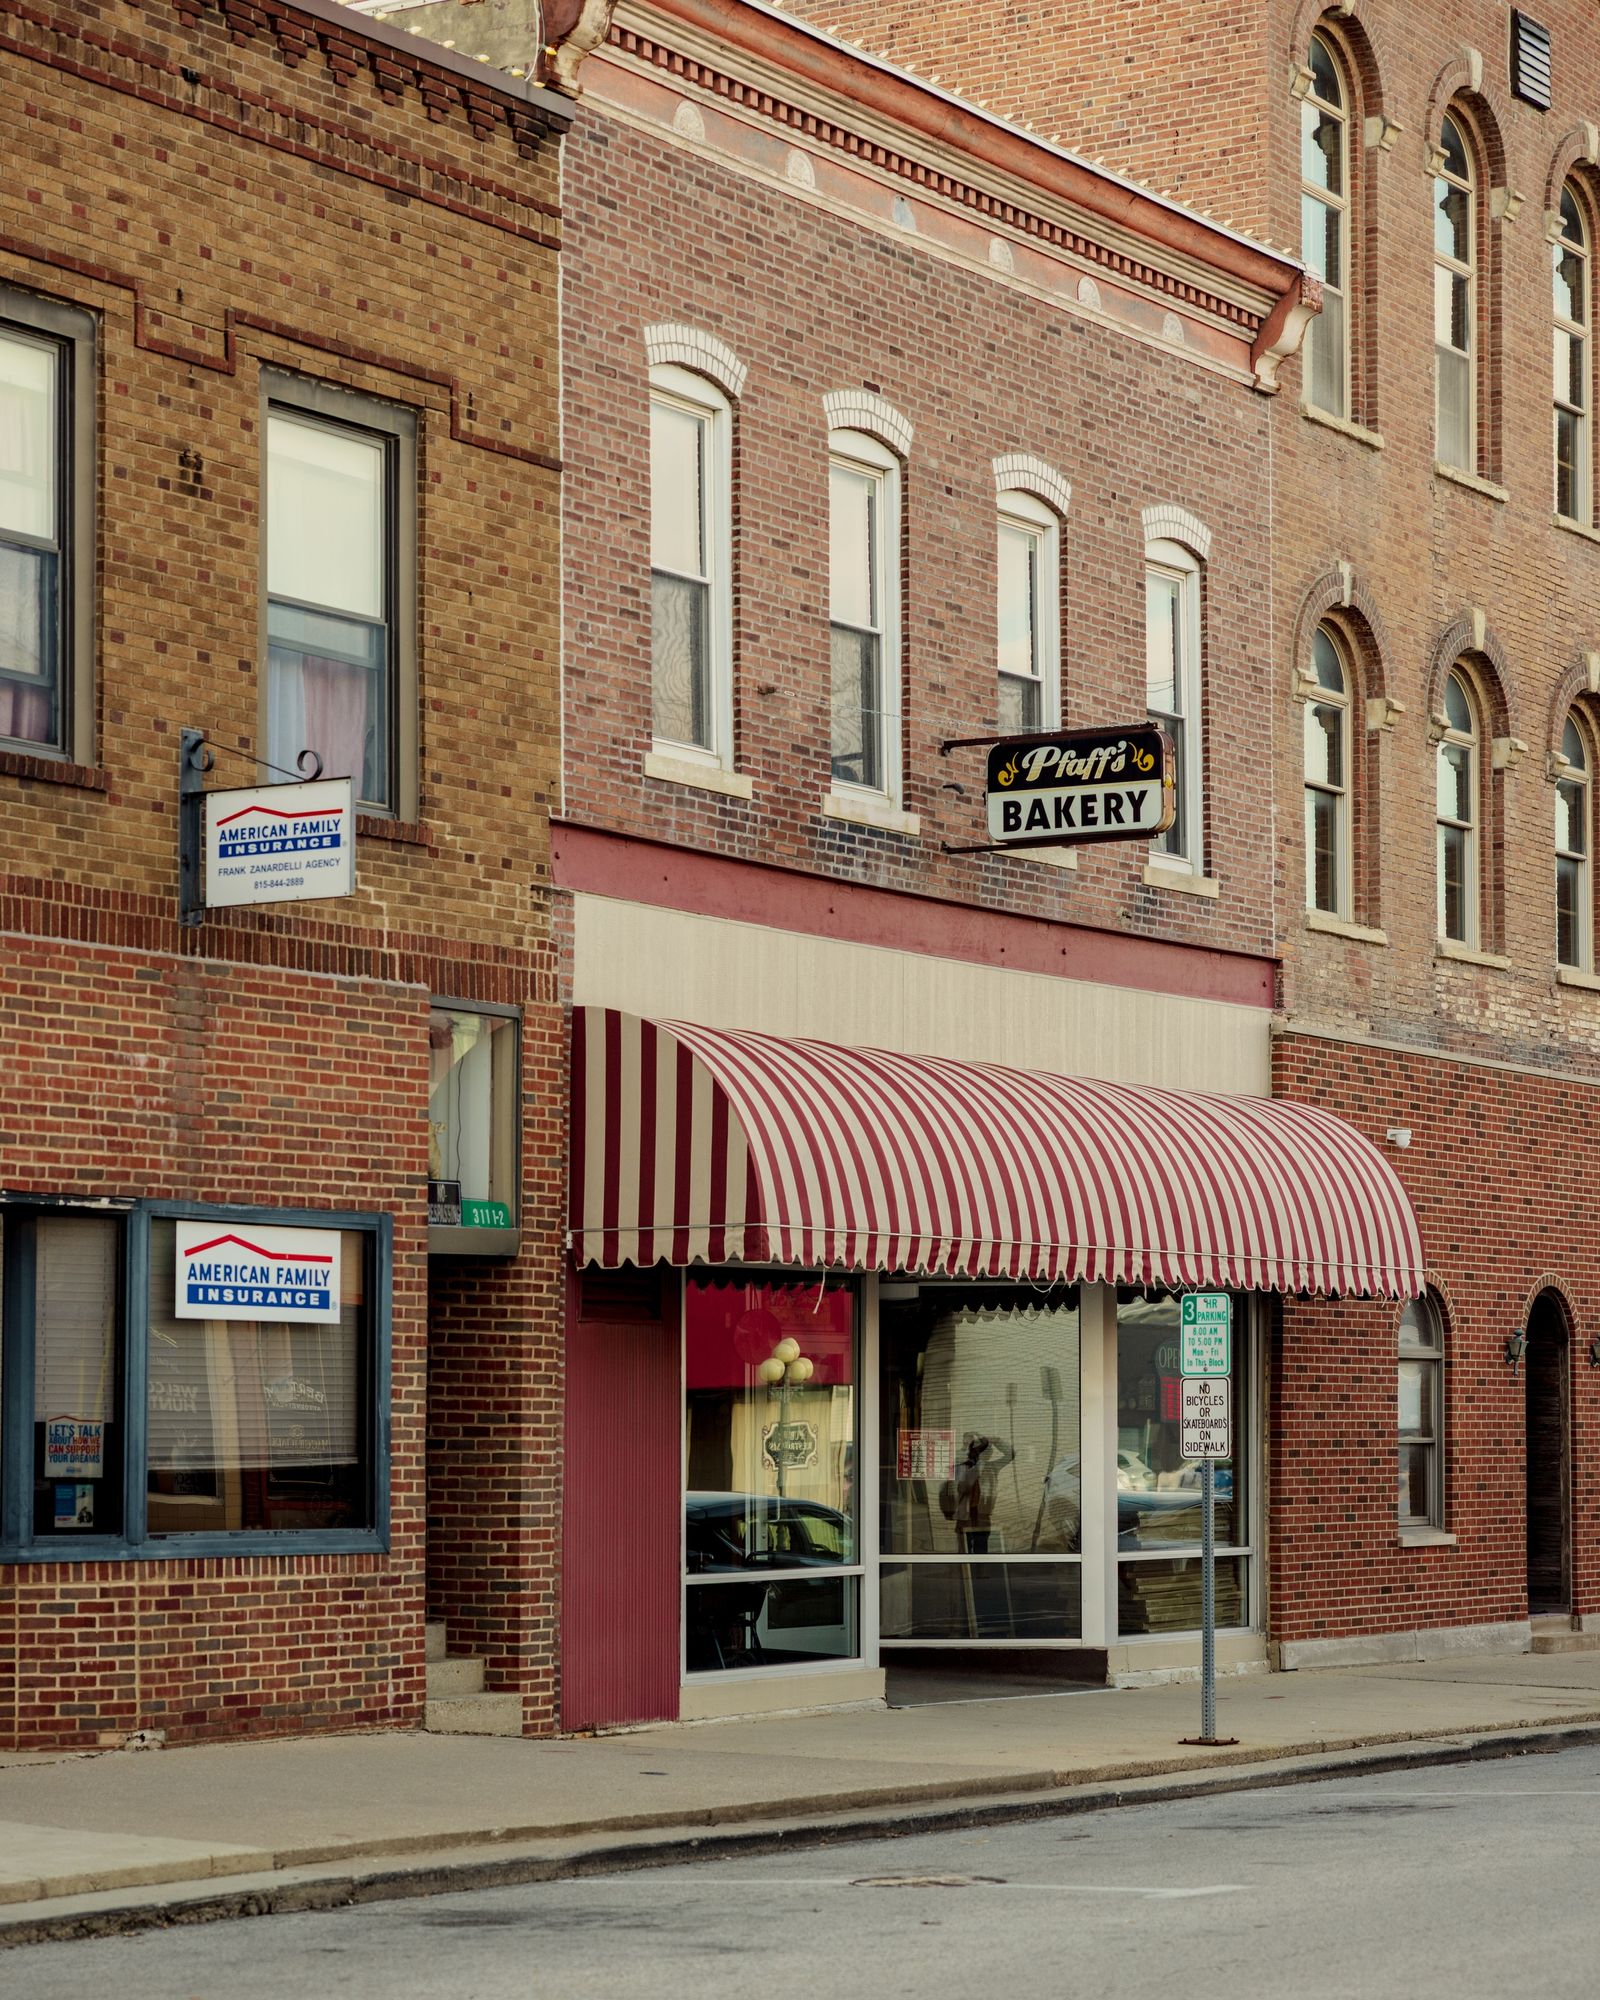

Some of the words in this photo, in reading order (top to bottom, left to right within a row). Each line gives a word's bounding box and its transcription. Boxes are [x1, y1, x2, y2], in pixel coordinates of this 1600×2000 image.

[1021, 740, 1128, 781] Pfaff's
[1003, 790, 1148, 833] BAKERY
[219, 823, 288, 842] AMERICAN
[293, 818, 341, 835] FAMILY
[227, 836, 332, 855] INSURANCE
[218, 866, 246, 877] FRANK
[250, 861, 302, 874] ZANARDELLI
[305, 857, 341, 869] AGENCY
[187, 1263, 270, 1284] AMERICAN
[277, 1267, 330, 1287] FAMILY
[198, 1288, 320, 1305] INSURANCE
[1184, 1301, 1195, 1321] 3
[1206, 1298, 1218, 1309] HR
[1197, 1311, 1226, 1322] PARKING
[1209, 1327, 1218, 1335] AM
[1188, 1337, 1196, 1346] TO
[1214, 1337, 1223, 1346] PM
[1192, 1348, 1204, 1356] Mon
[1210, 1348, 1219, 1356] Fri
[1158, 1347, 1180, 1368] OPE
[1187, 1358, 1194, 1367] In
[1195, 1358, 1208, 1367] This
[1208, 1358, 1225, 1367] Block
[1199, 1384, 1211, 1394] NO
[1186, 1396, 1225, 1406] BICYCLES
[1199, 1408, 1211, 1417] OR
[1183, 1418, 1227, 1429] SKATEBOARDS
[48, 1425, 74, 1437] LET'S
[77, 1425, 101, 1437] TALK
[1199, 1430, 1211, 1440] ON
[48, 1437, 71, 1445] ABOUT
[72, 1437, 88, 1445] HOW
[90, 1437, 100, 1445] WE
[48, 1445, 64, 1454] CAN
[65, 1445, 100, 1454] SUPPORT
[1185, 1442, 1226, 1452] SIDEWALK
[48, 1454, 69, 1463] YOUR
[69, 1454, 100, 1463] DREAMS
